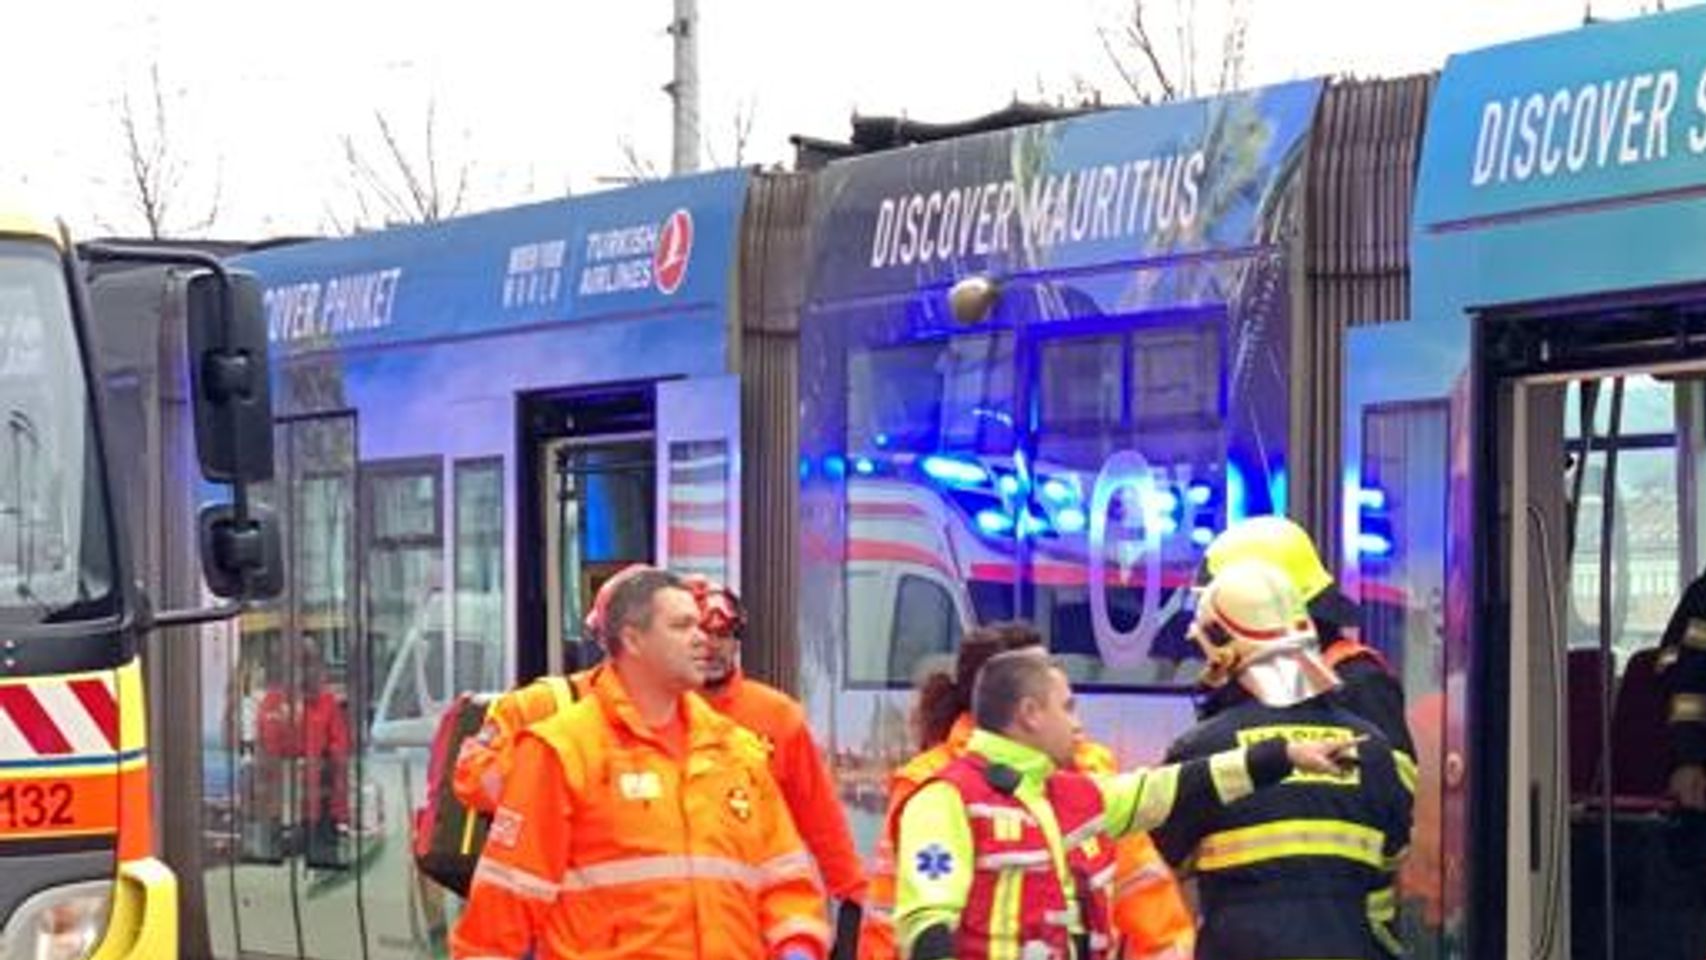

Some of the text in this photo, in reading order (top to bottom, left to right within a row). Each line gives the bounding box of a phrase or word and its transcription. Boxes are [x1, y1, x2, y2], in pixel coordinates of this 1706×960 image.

[1471, 69, 1679, 187] DISCOVER
[870, 152, 1204, 267] DISCOVER MAURITIUS
[321, 267, 402, 334] PHUKET
